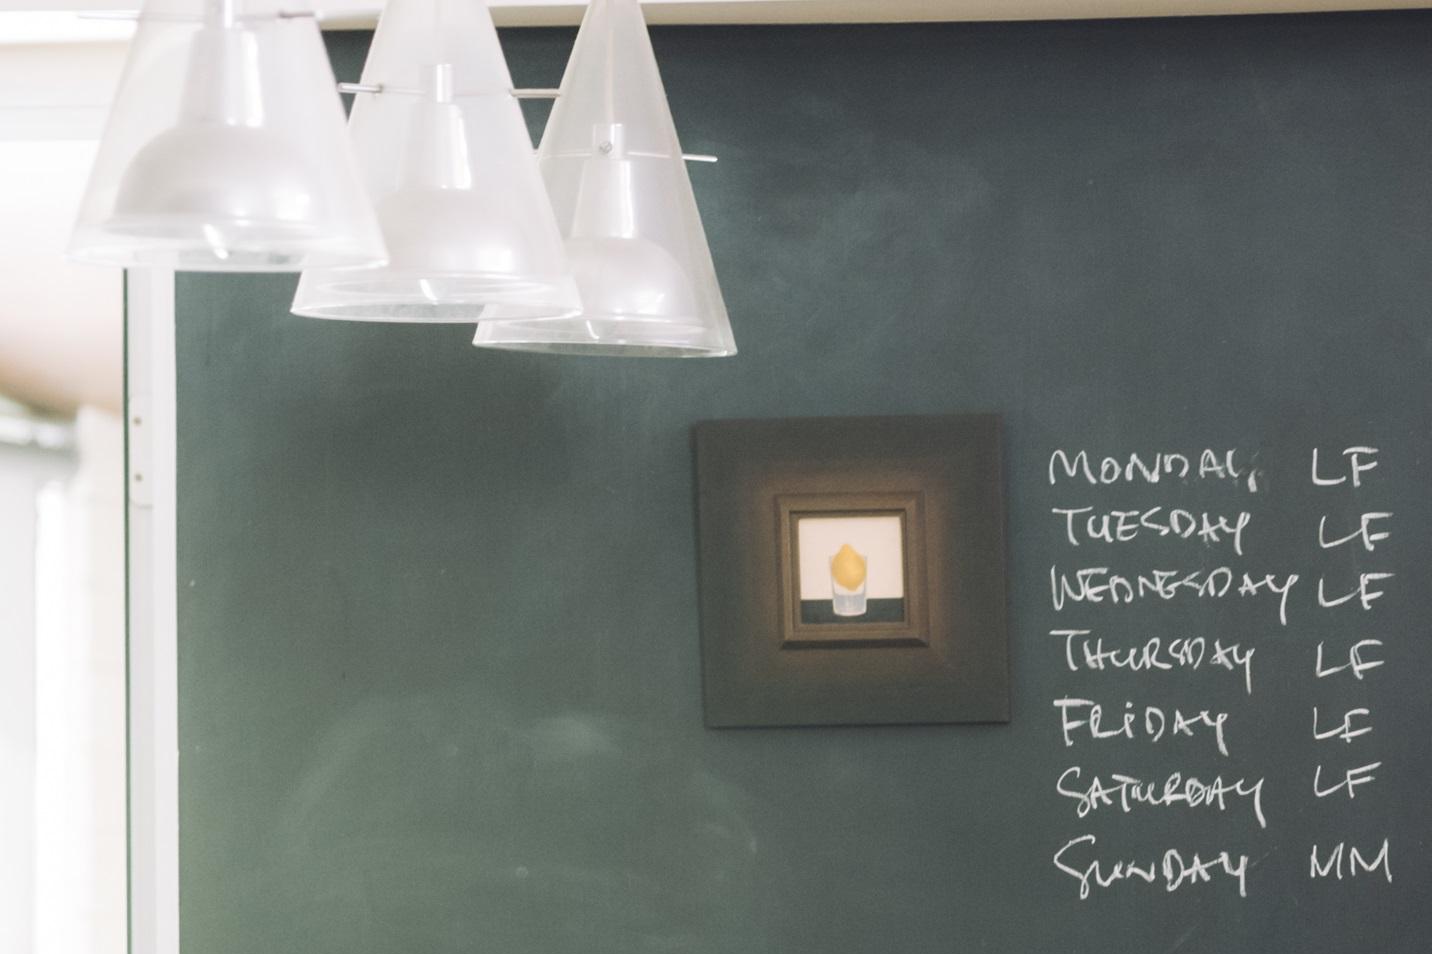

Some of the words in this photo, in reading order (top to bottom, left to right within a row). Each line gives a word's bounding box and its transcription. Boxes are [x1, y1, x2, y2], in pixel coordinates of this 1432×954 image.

[1311, 446, 1380, 489] LF
[1051, 505, 1252, 557] TUESDAY
[1318, 511, 1395, 552] LF
[1049, 564, 1301, 627] WEDNESDAY
[1317, 572, 1396, 611] LF
[1048, 629, 1257, 695] THURSDAY
[1315, 639, 1386, 681] LF
[1312, 706, 1374, 744] LF
[1055, 765, 1268, 830] SATURDAY
[1313, 761, 1384, 800] LF
[1052, 834, 1250, 901] SUNDAY
[1309, 838, 1394, 884] MM
